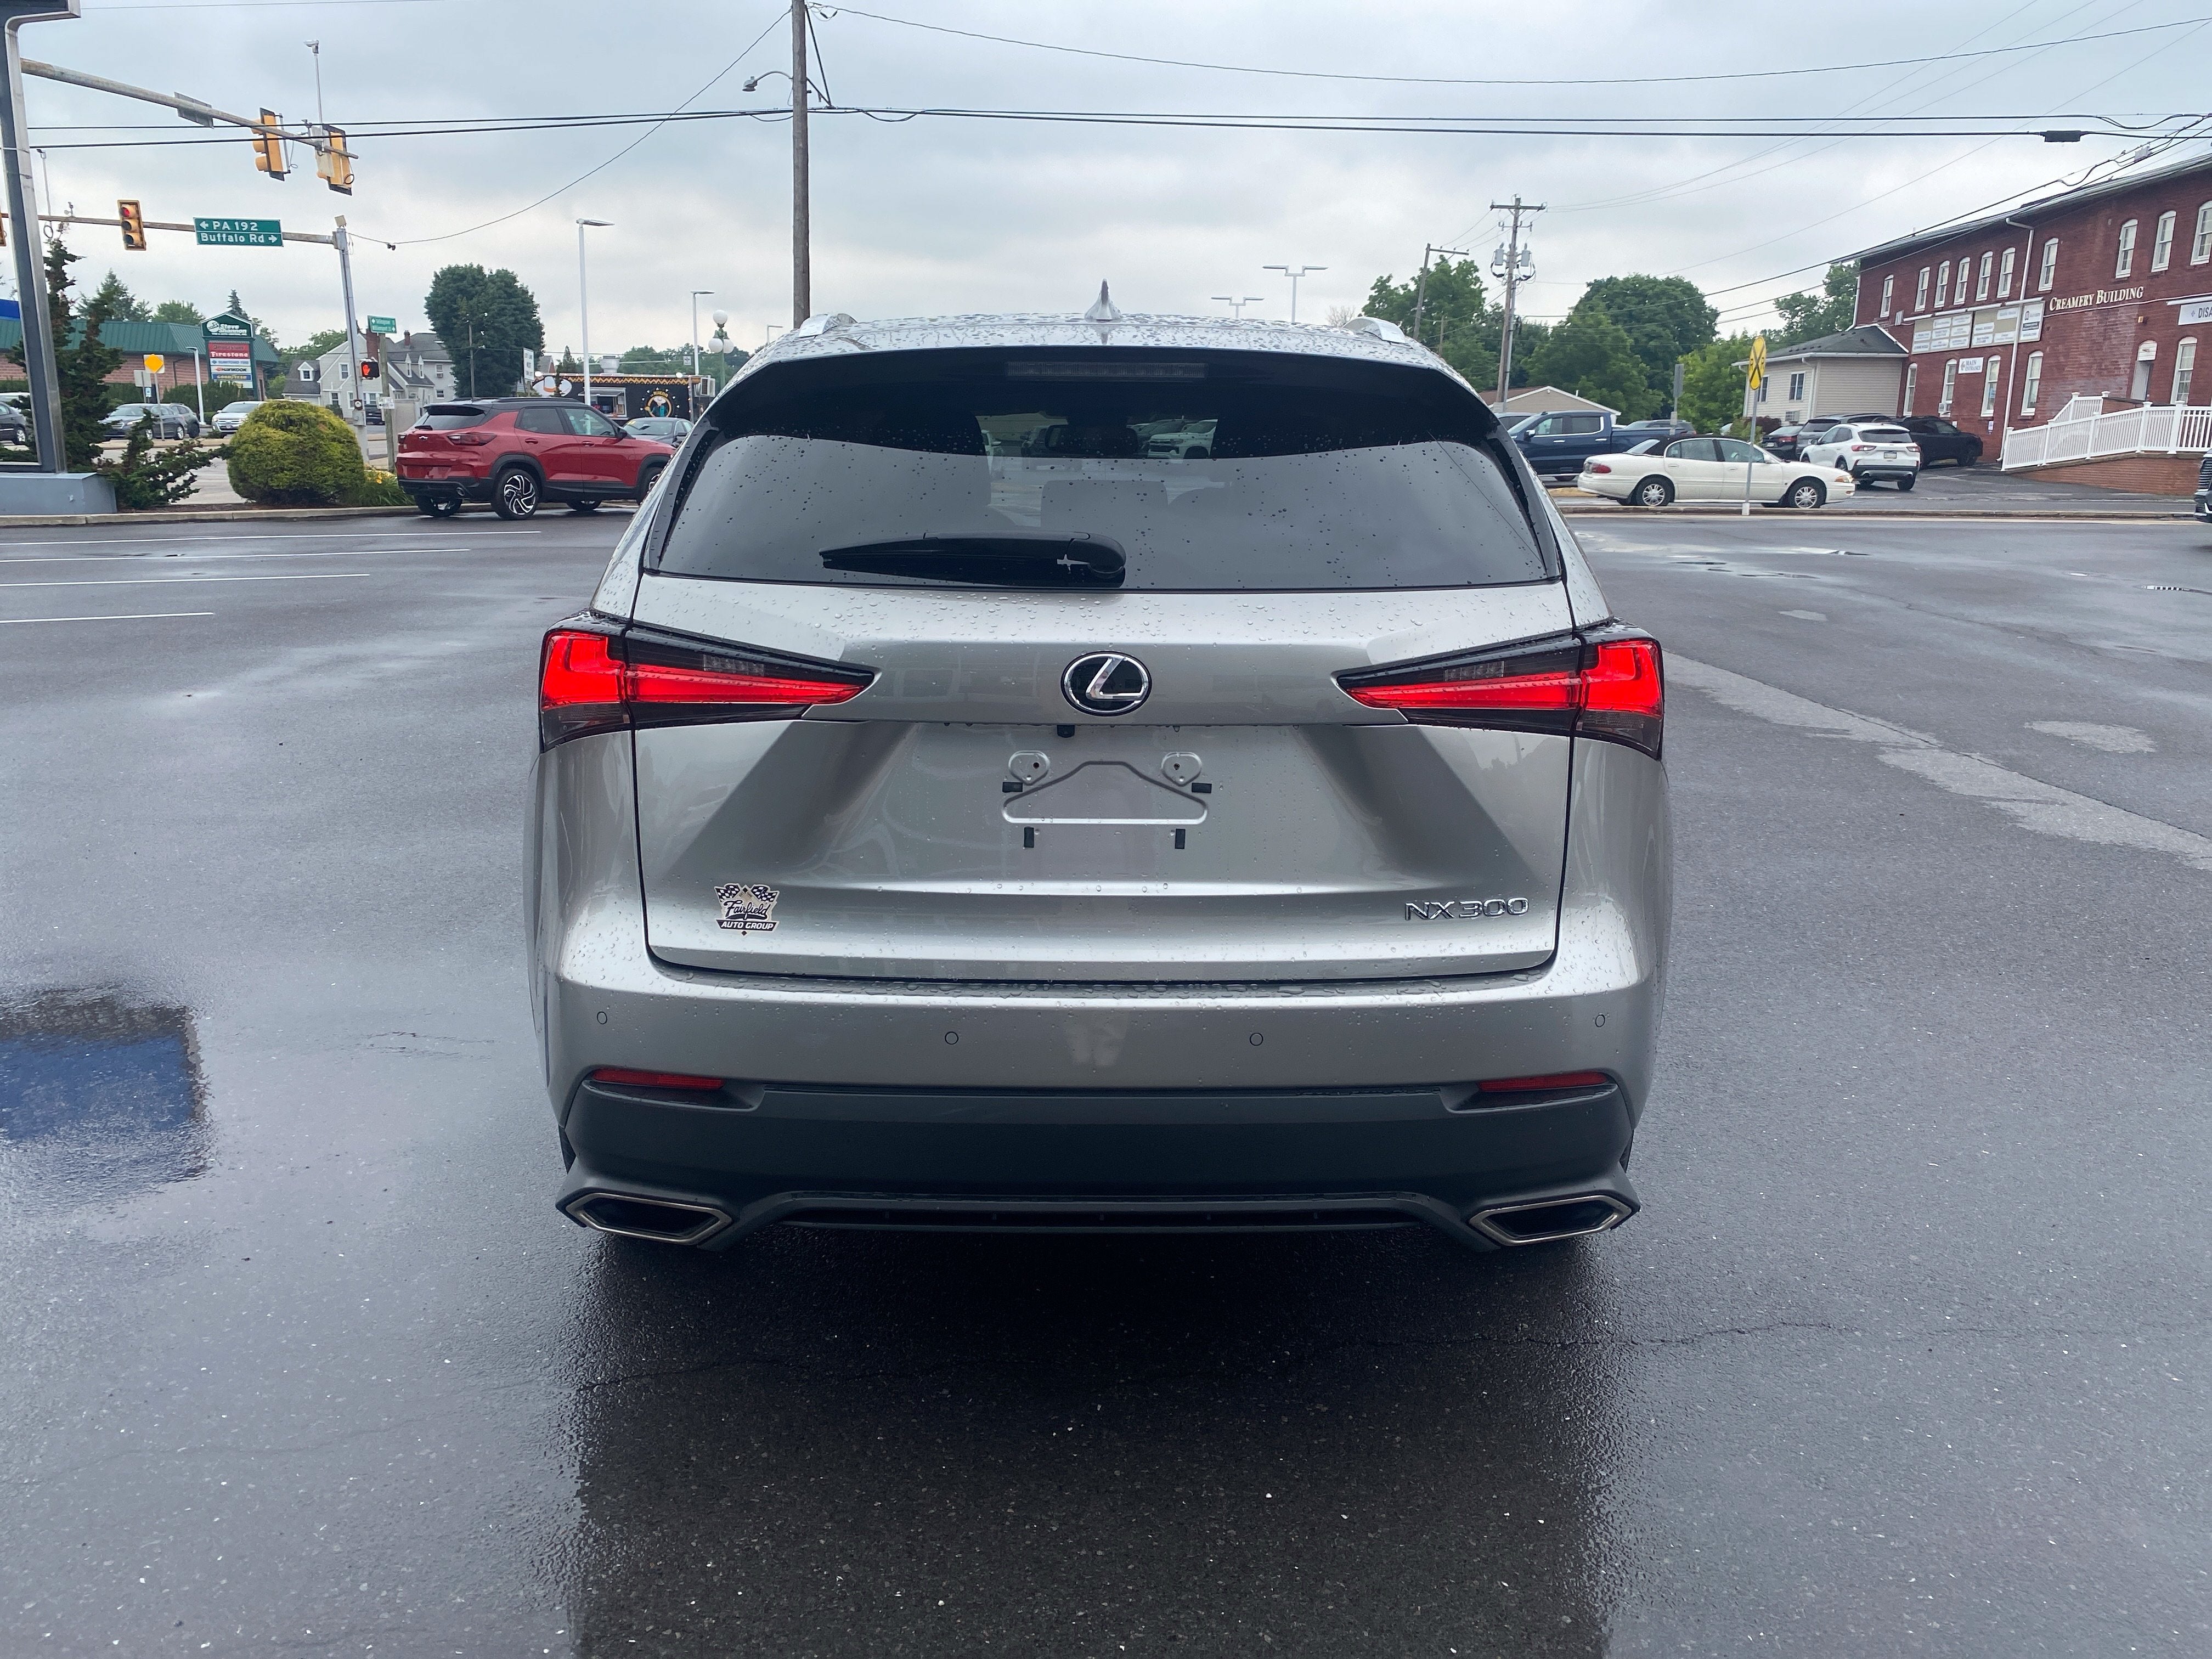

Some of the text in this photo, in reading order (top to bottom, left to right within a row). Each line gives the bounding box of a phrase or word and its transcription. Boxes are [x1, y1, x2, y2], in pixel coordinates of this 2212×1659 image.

[212, 221, 258, 231] PA 192
[200, 233, 264, 243] Buffalo Rd
[723, 899, 771, 918] Fairfield
